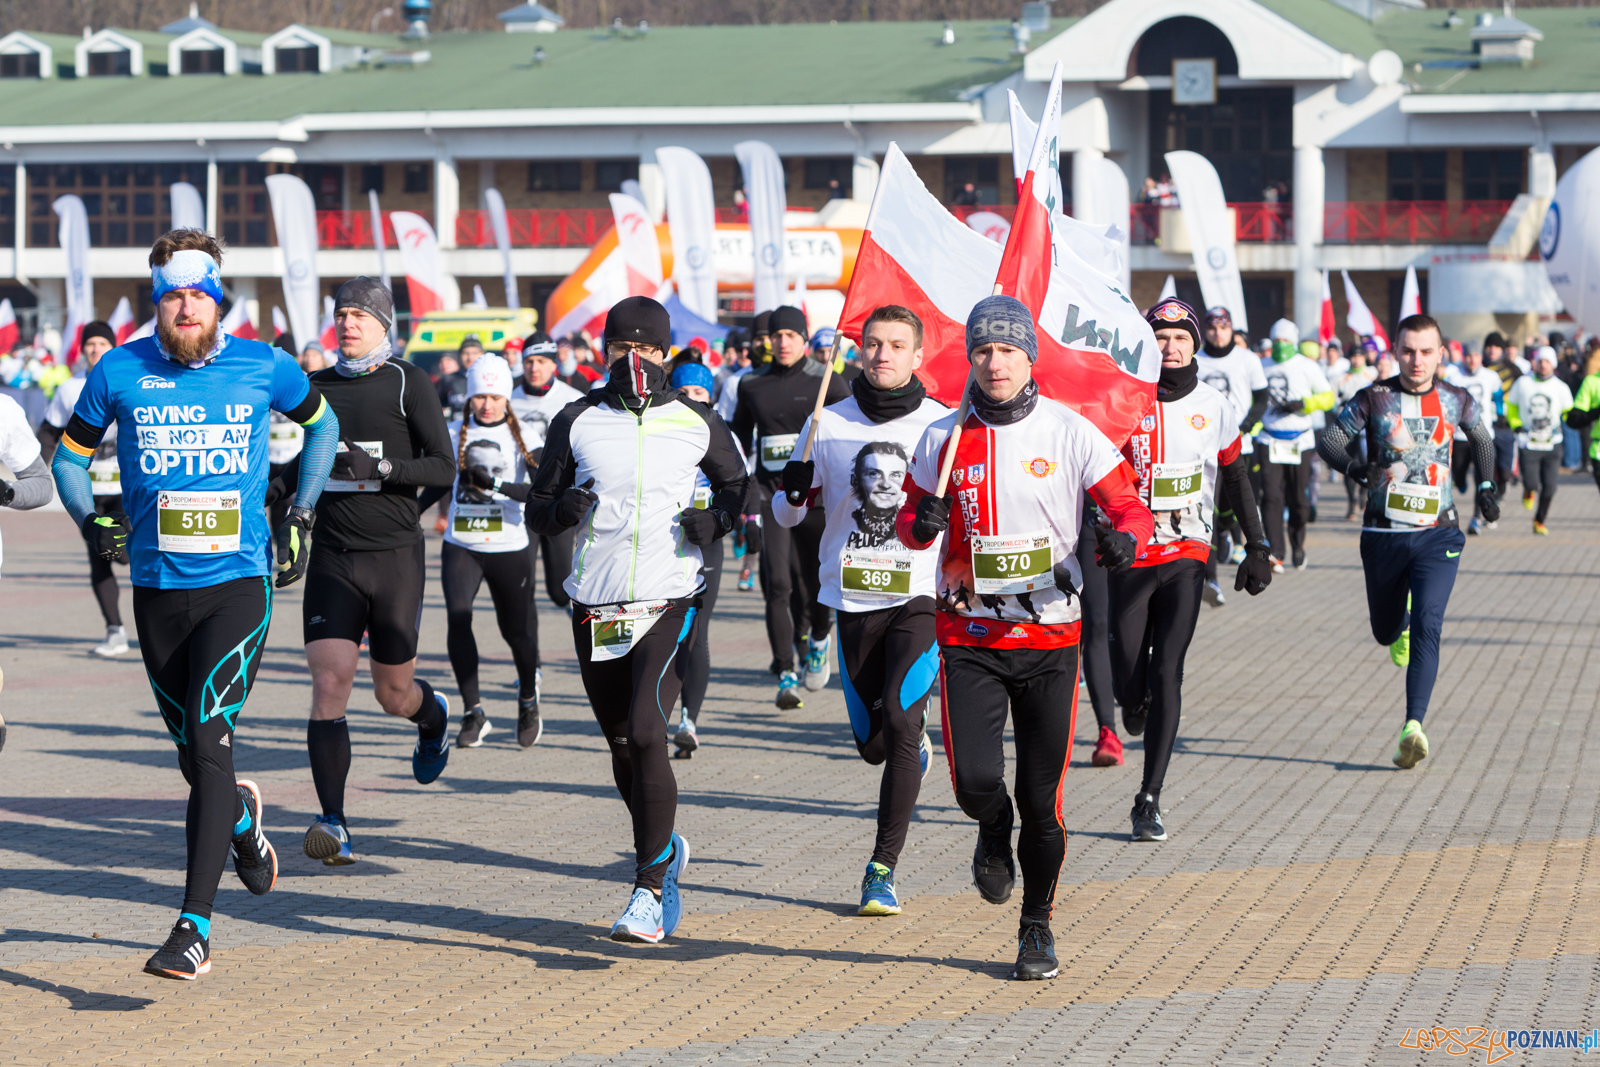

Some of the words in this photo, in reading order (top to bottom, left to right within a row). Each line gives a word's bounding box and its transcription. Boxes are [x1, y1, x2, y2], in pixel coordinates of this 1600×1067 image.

[142, 381, 176, 389] Enea
[132, 405, 207, 425] GIVING
[225, 404, 254, 423] UP
[140, 430, 159, 446] IS
[168, 429, 210, 445] NOT
[221, 429, 248, 444] AN
[139, 448, 249, 476] OPTION
[1171, 476, 1192, 493] 188
[1402, 495, 1426, 511] 769
[181, 511, 218, 529] 516
[465, 517, 490, 530] 744
[984, 538, 1030, 548] TROPEMWILCZYM
[995, 553, 1031, 572] 370
[861, 569, 892, 587] 369
